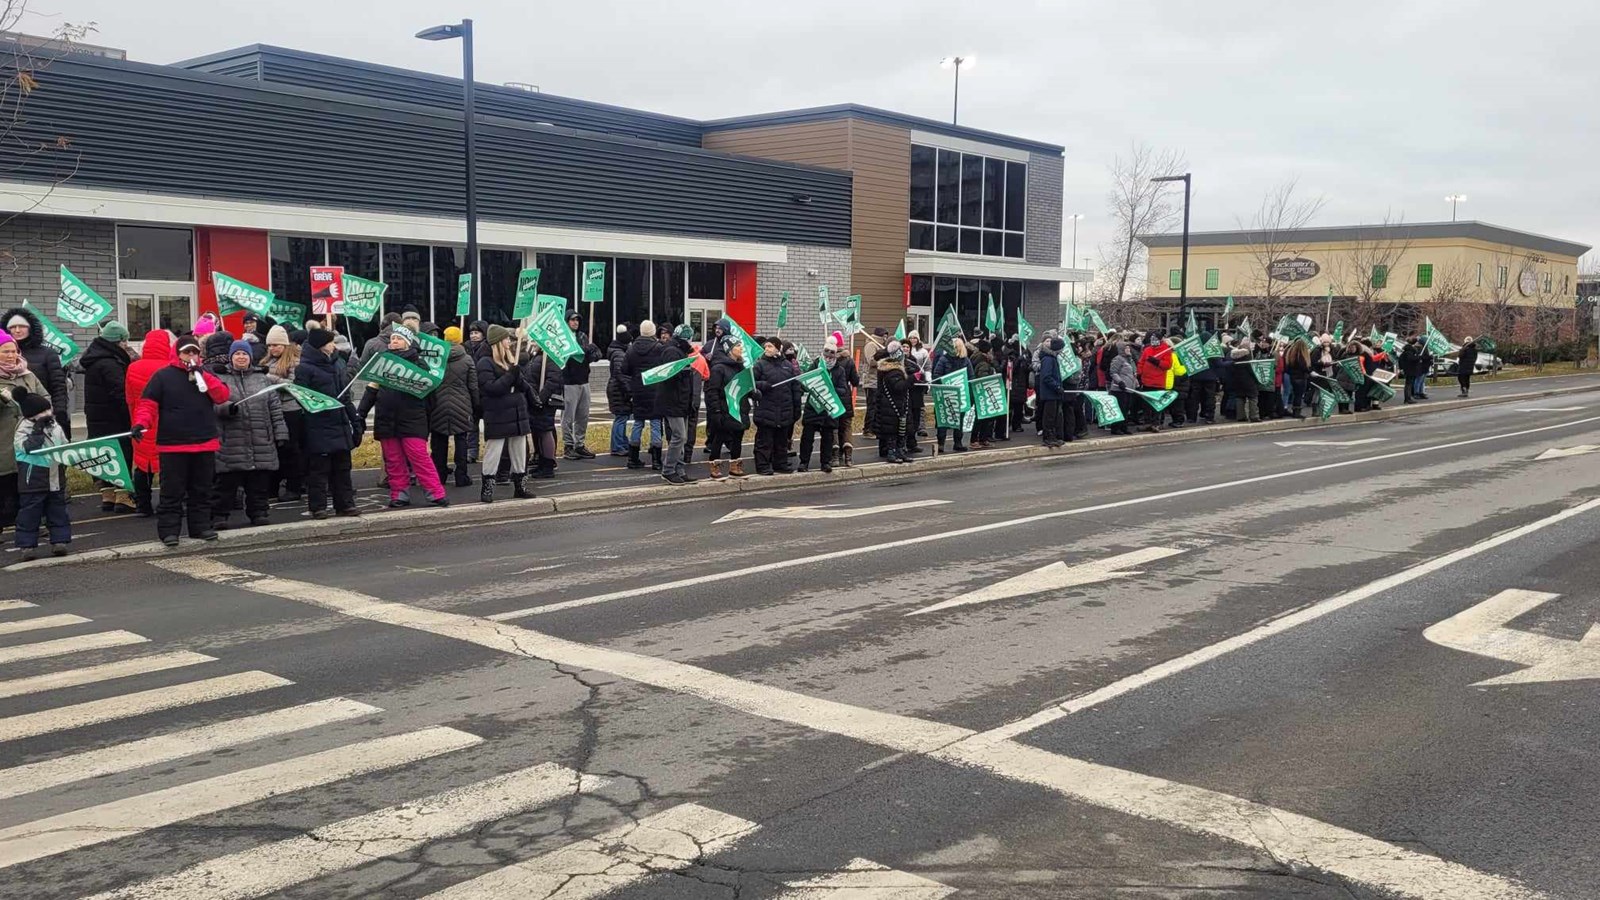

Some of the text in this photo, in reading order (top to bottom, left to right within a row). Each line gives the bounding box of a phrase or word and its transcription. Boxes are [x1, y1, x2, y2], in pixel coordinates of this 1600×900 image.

[313, 271, 333, 281] GRÈVE
[216, 278, 268, 311] NOUS
[1184, 340, 1208, 369] NOUS
[369, 356, 434, 391] NOUS
[805, 374, 840, 414] NOUS
[943, 389, 961, 426] NOUS
[982, 379, 1004, 414] NOUS
